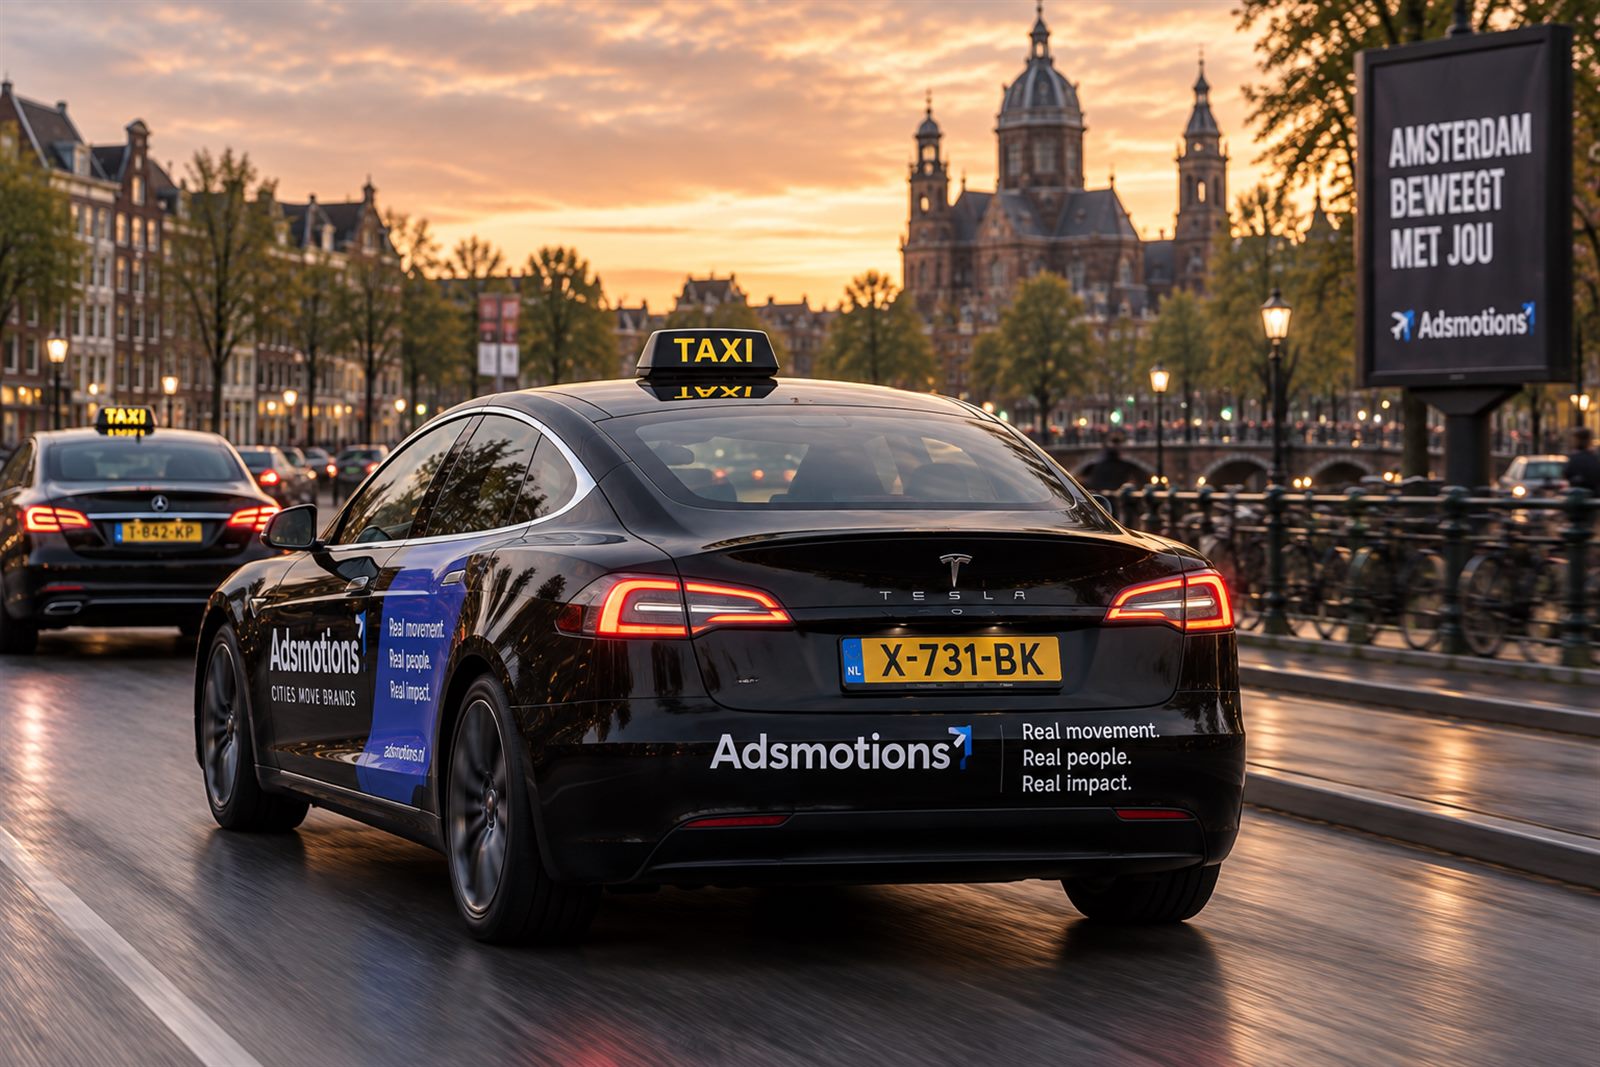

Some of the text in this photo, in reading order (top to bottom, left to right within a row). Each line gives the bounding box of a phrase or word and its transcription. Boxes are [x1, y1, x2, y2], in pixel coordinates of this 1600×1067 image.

[1389, 112, 1532, 168] AMSTERDAM
[1390, 168, 1505, 219] BEWEEGT
[1391, 222, 1494, 269] MET JOU
[1418, 306, 1528, 339] Adsmotions
[673, 337, 753, 363] TAXI
[104, 407, 147, 425] TAXI
[879, 590, 1026, 601] TESLA
[389, 617, 445, 639] Real movement.
[269, 628, 360, 674] Adsmotions
[389, 648, 432, 674] Real people.
[847, 642, 1044, 678] NL X-731-BK
[271, 685, 356, 707] CITIES MOVE BRANDS
[389, 680, 431, 705] Real impact.
[1022, 722, 1161, 741] Real movement.
[709, 732, 950, 771] Adsmotions
[1022, 747, 1132, 770] Real people.
[1022, 774, 1132, 796] Real impact.
